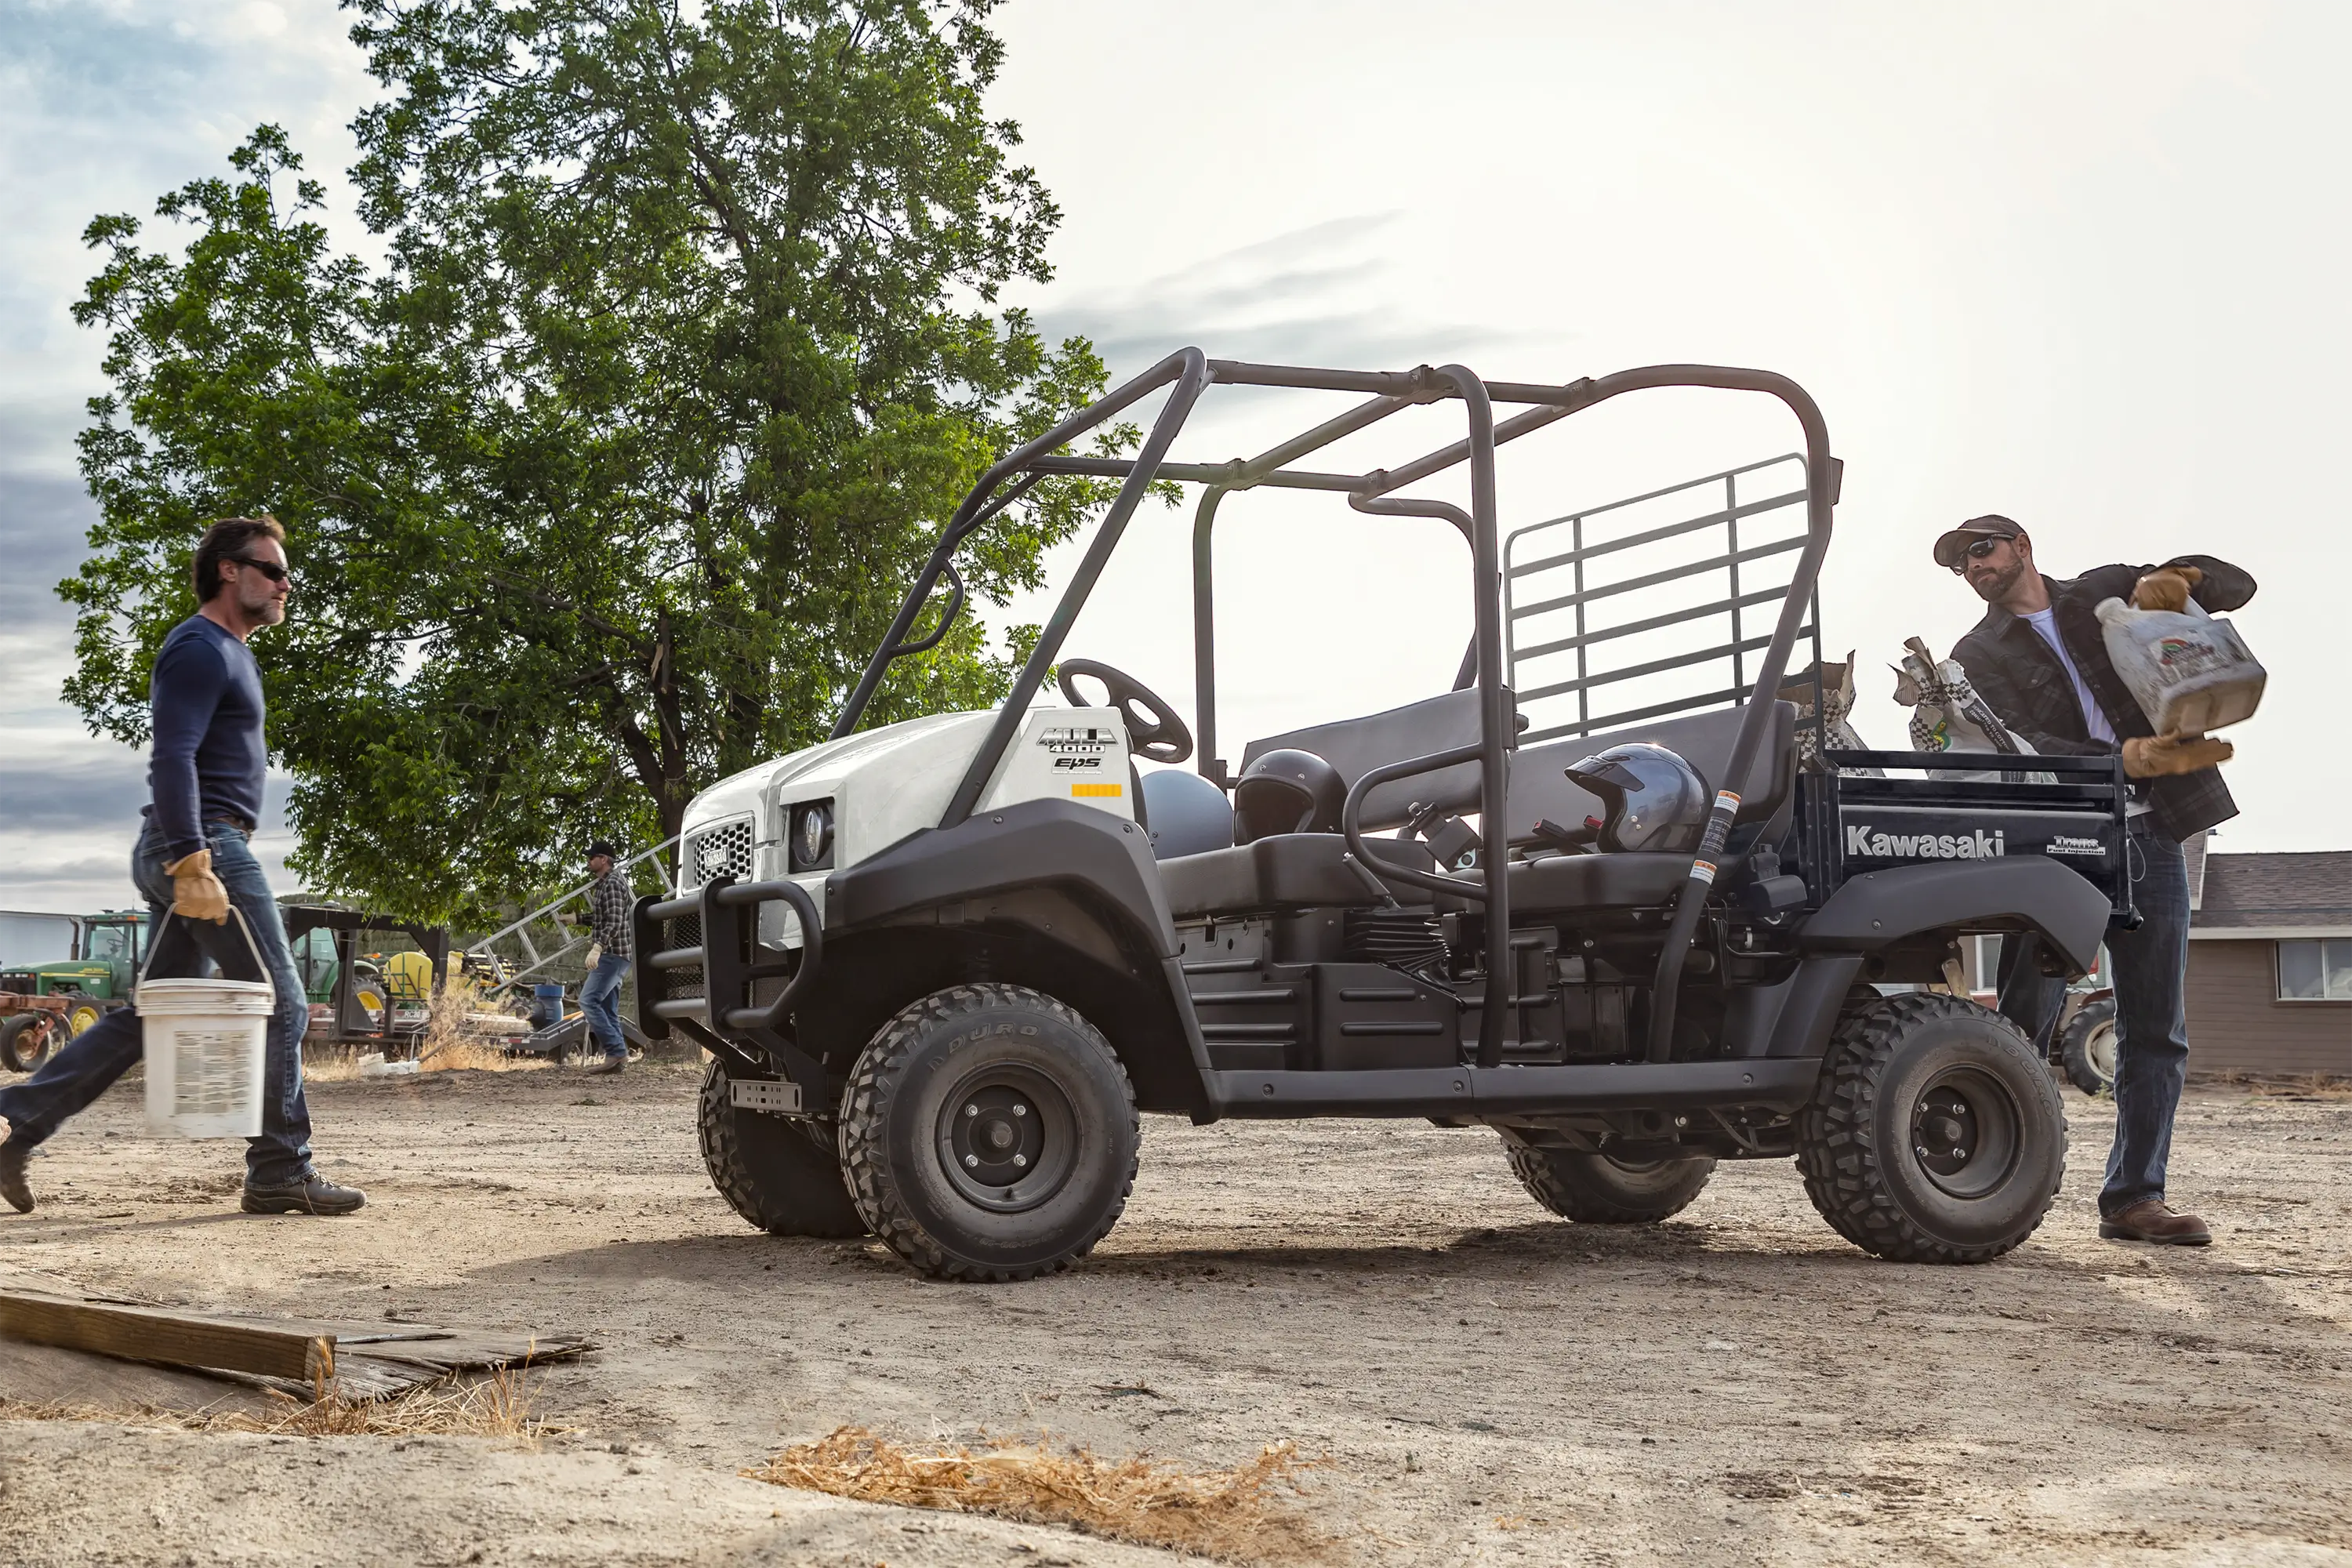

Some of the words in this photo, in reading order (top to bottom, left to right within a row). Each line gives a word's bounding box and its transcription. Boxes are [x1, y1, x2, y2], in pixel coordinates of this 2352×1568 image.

[1036, 728, 1120, 746] MULE
[1846, 826, 2005, 858] Kawasaki
[2053, 835, 2100, 849] Trans
[949, 1022, 1039, 1054] DURO
[2004, 1045, 2054, 1117] DURO
